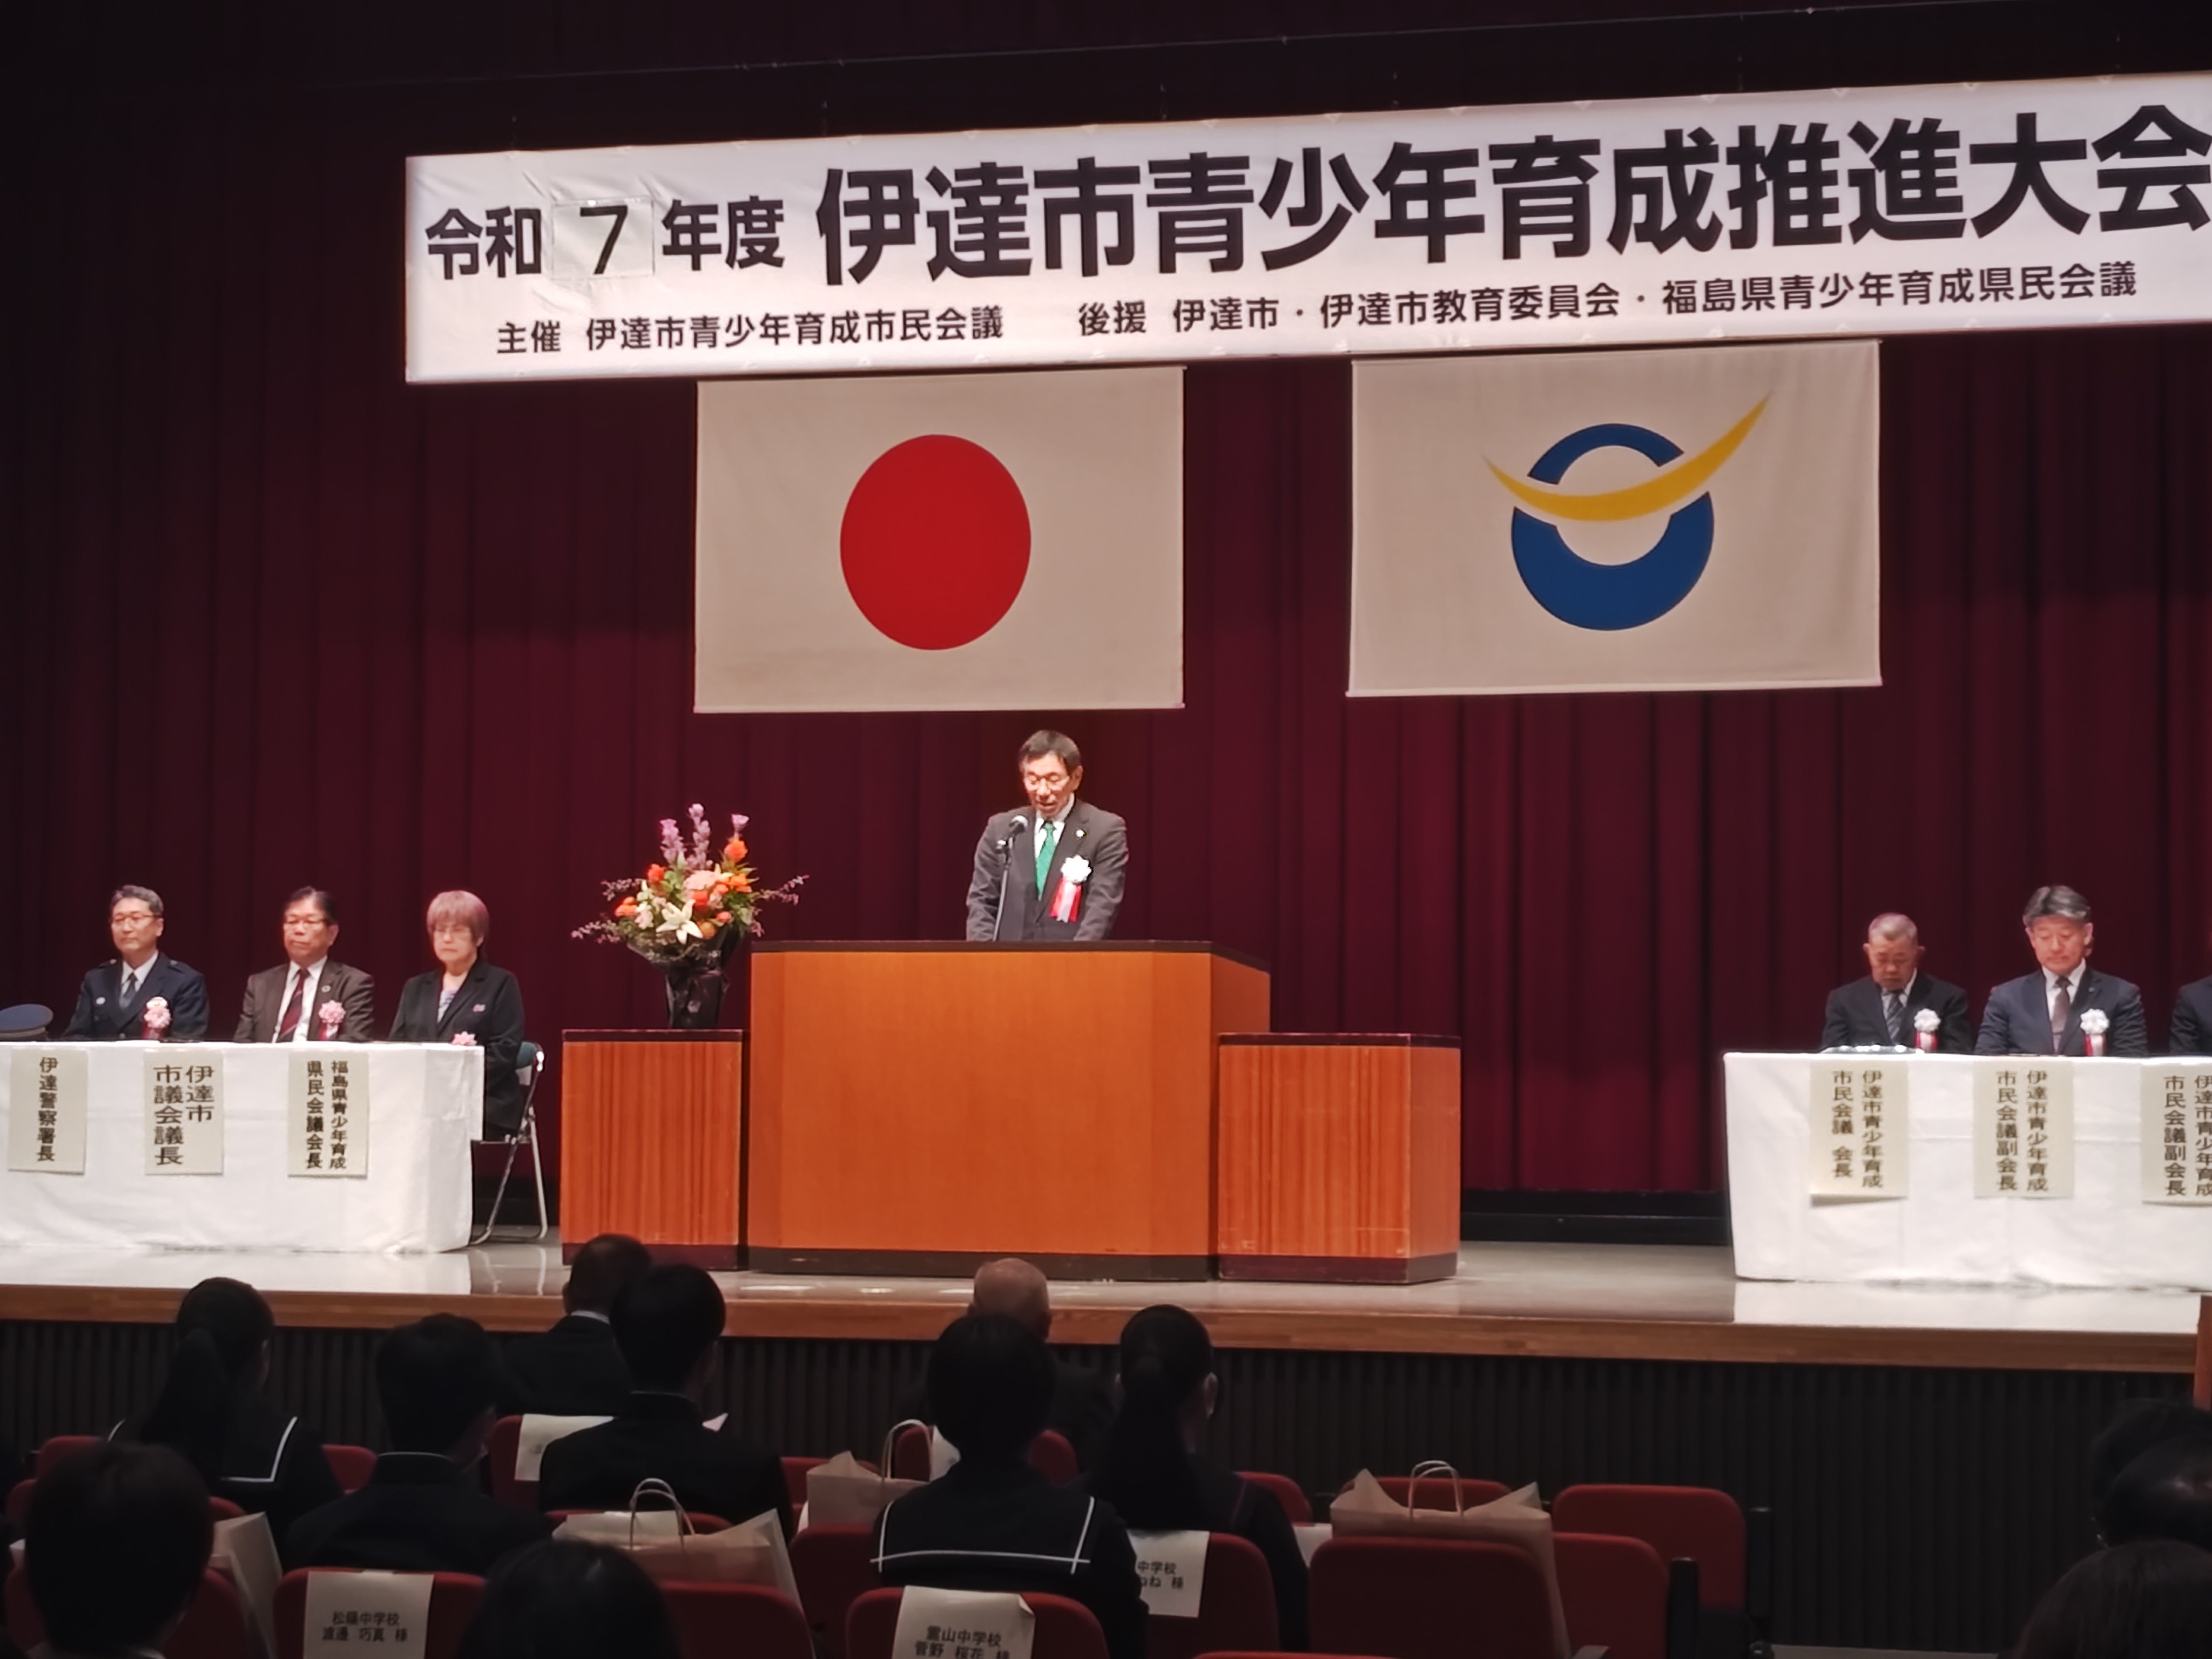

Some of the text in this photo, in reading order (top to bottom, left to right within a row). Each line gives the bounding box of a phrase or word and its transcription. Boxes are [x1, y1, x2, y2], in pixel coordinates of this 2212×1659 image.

[816, 104, 2212, 285] 伊達市青少年育成推進大会
[497, 320, 561, 354] 主催
[585, 306, 1003, 350] 伊達市青少年育成市民会議
[1078, 301, 1147, 336] 後援
[37, 1057, 58, 1162] 伊達警察署長
[153, 1064, 184, 1165] 市議会議長
[185, 1065, 214, 1123] 伊達市
[306, 1061, 325, 1169] 県民会議会長
[329, 1061, 349, 1169] 福島県青少年育成
[1862, 1070, 1883, 1188] 伊達市青少年育成
[1996, 1070, 2018, 1191] 市民会議副会長
[2027, 1070, 2048, 1191] 伊達市青少年育成
[2163, 1075, 2187, 1196] 市民会議副会長
